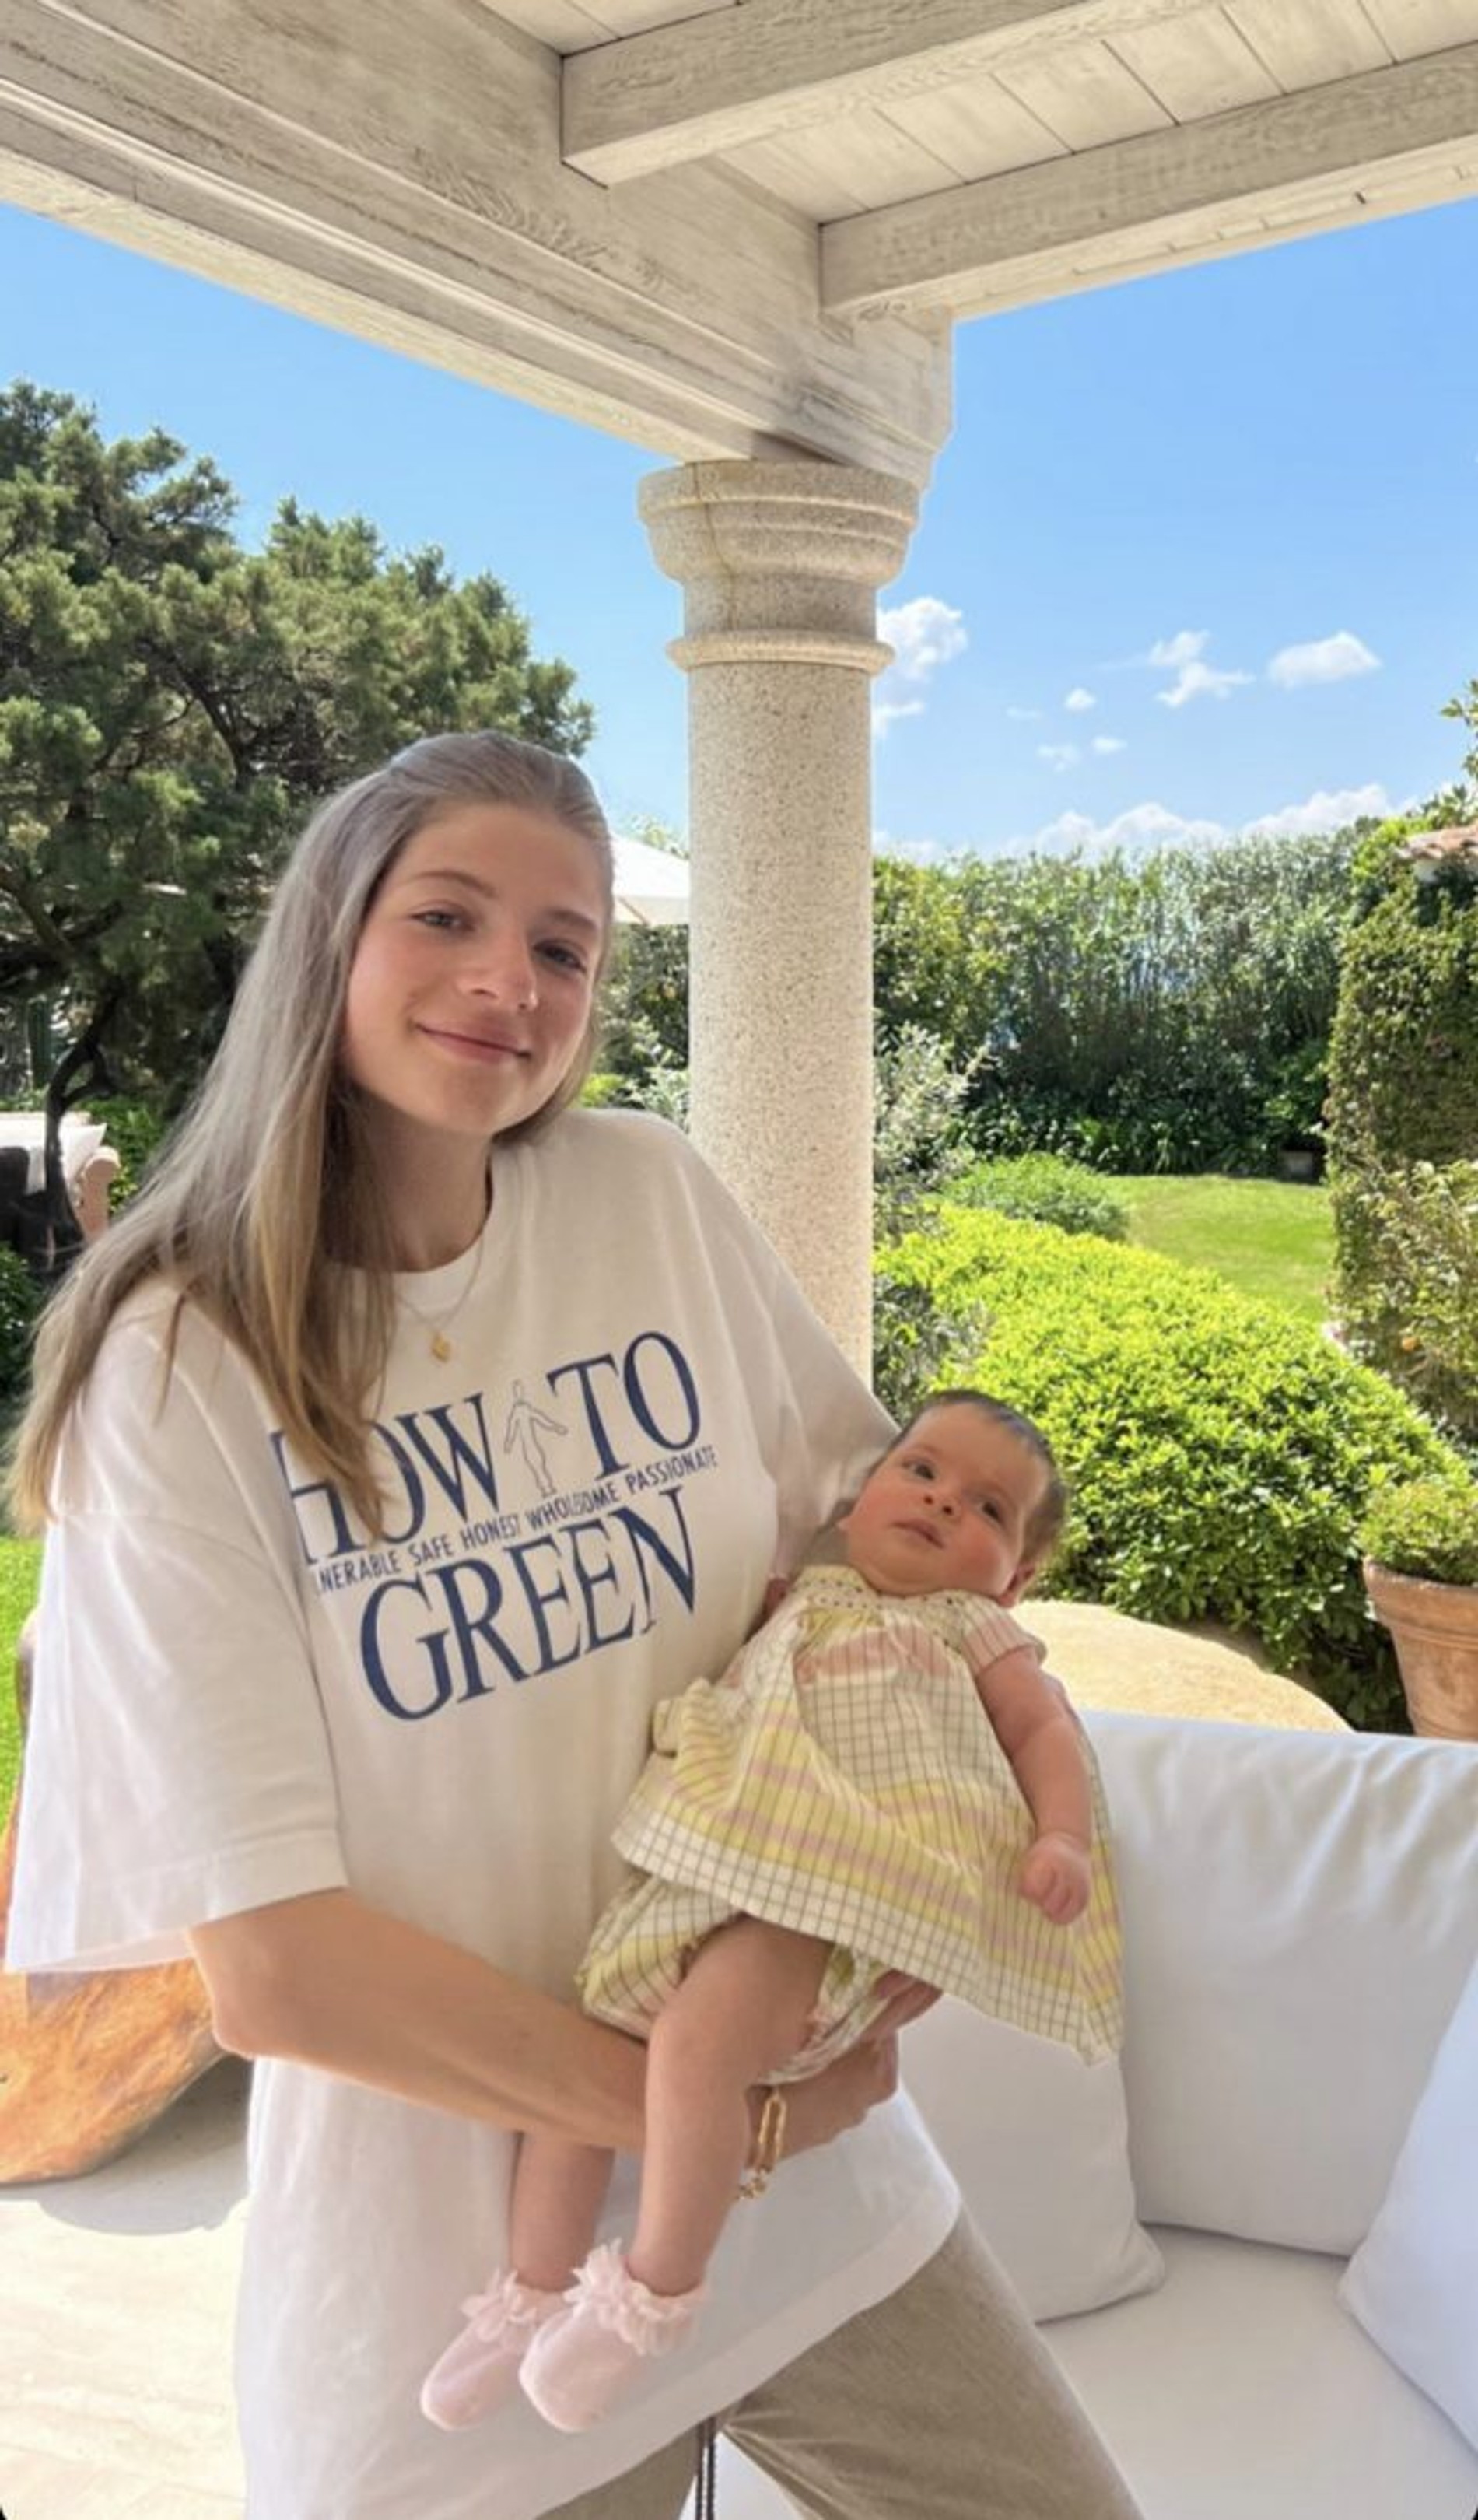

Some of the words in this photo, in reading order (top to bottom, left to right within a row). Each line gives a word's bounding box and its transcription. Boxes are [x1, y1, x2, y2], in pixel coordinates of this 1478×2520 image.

[548, 1331, 701, 1480] TO
[318, 1550, 401, 1592] NERABLE
[408, 1534, 454, 1566] SAFE
[460, 1513, 520, 1551] HONEST
[625, 1445, 718, 1495] PASSIONATE
[360, 1487, 695, 1719] GREEN
